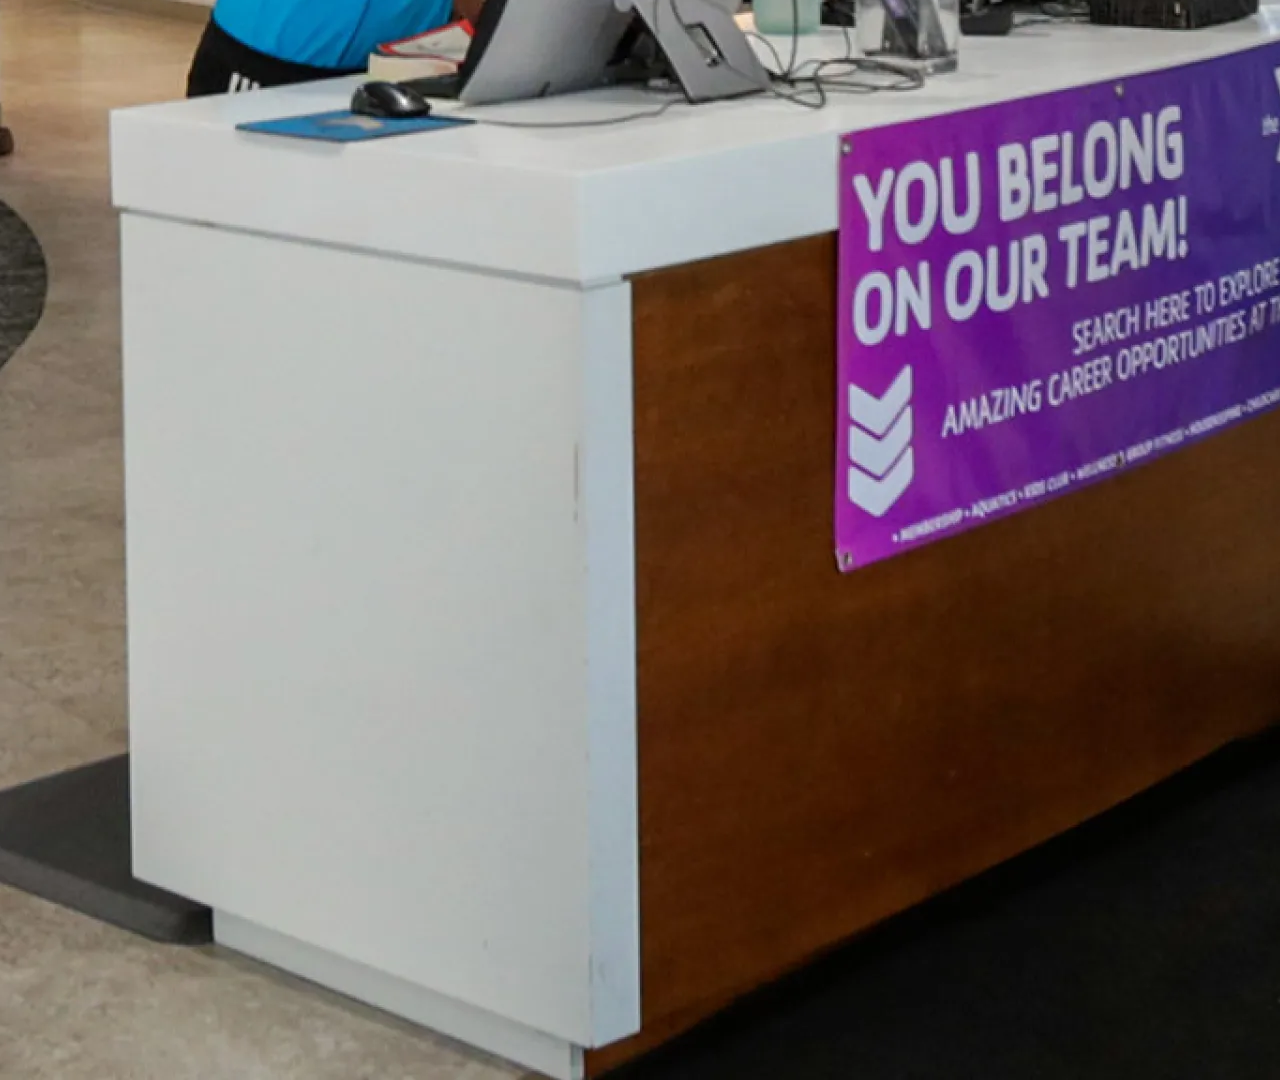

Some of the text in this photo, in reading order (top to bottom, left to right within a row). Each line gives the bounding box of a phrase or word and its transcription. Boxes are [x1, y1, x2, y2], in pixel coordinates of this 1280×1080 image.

[852, 104, 1185, 251] YOU BELONG
[851, 195, 1189, 347] ON OUR TEAM!
[1072, 307, 1141, 357] SEARCH
[1145, 289, 1192, 334] HERE
[1195, 283, 1217, 313] TO
[1219, 262, 1280, 308] EXPLORE
[941, 378, 1043, 440] AMAZING
[1047, 355, 1114, 408] CAREER
[1116, 311, 1247, 382] OPPORTUNITIES
[1248, 302, 1268, 331] AT
